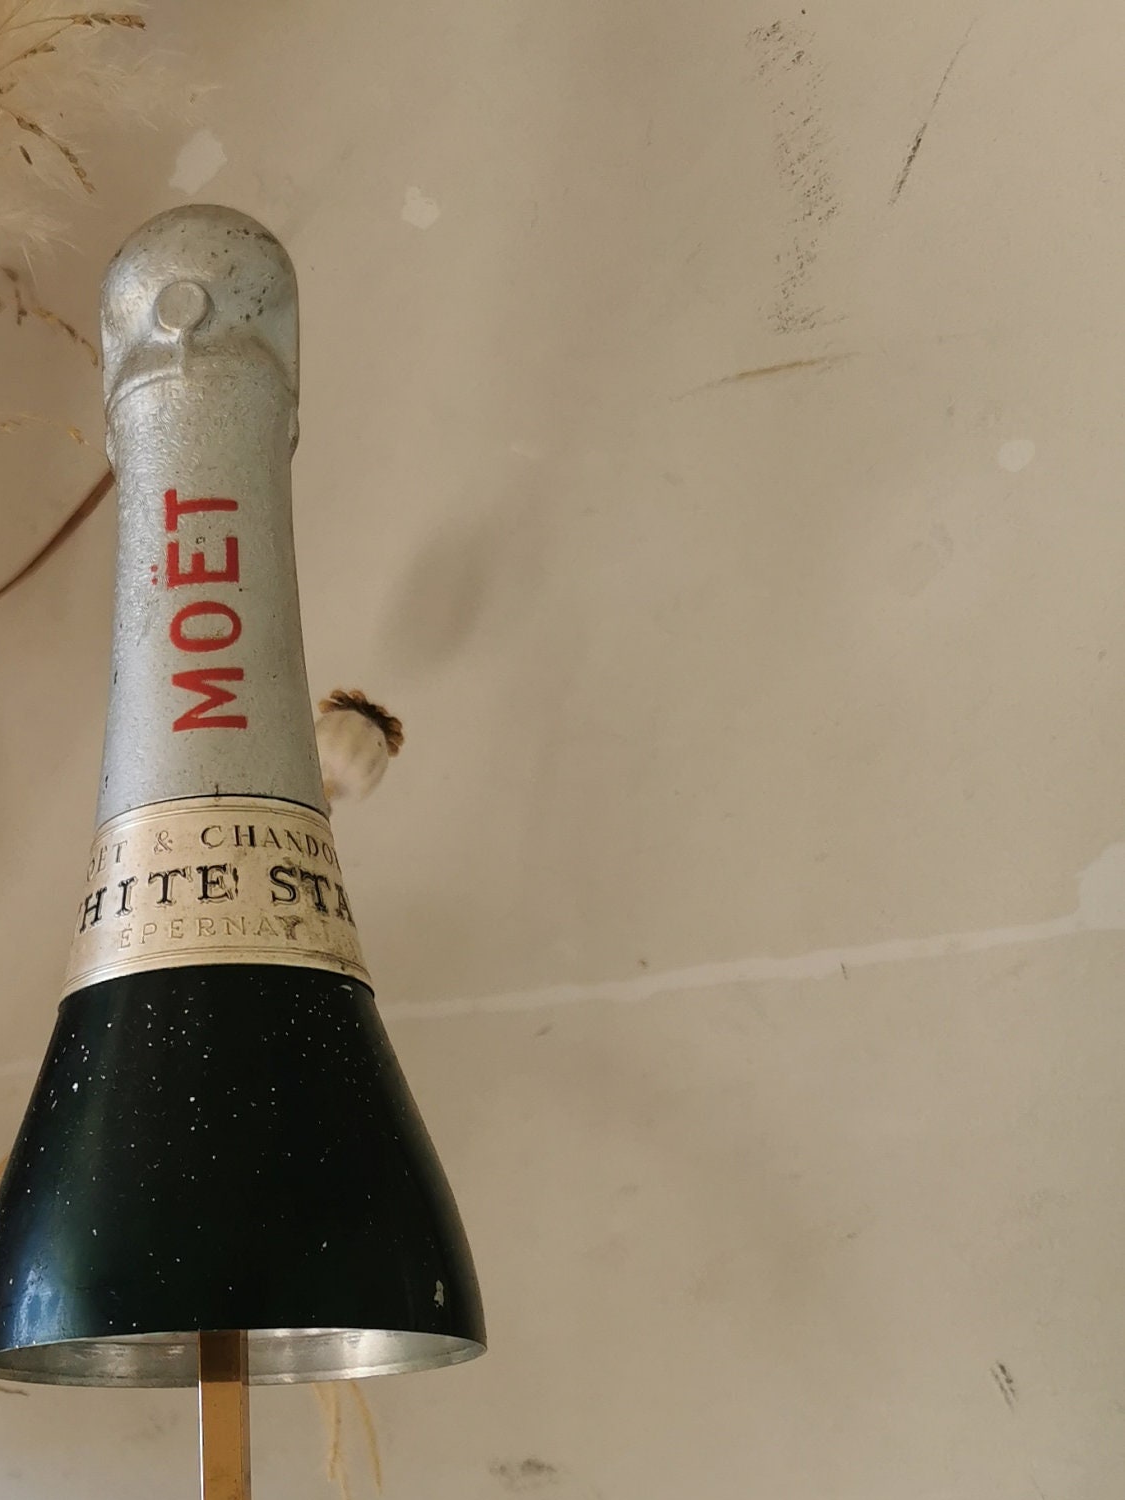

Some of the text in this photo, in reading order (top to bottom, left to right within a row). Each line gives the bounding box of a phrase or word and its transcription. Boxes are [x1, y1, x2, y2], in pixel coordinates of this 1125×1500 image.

[150, 488, 248, 732] MOËT
[86, 839, 128, 883] OET
[153, 829, 174, 855] &
[76, 863, 356, 935] HITE STA
